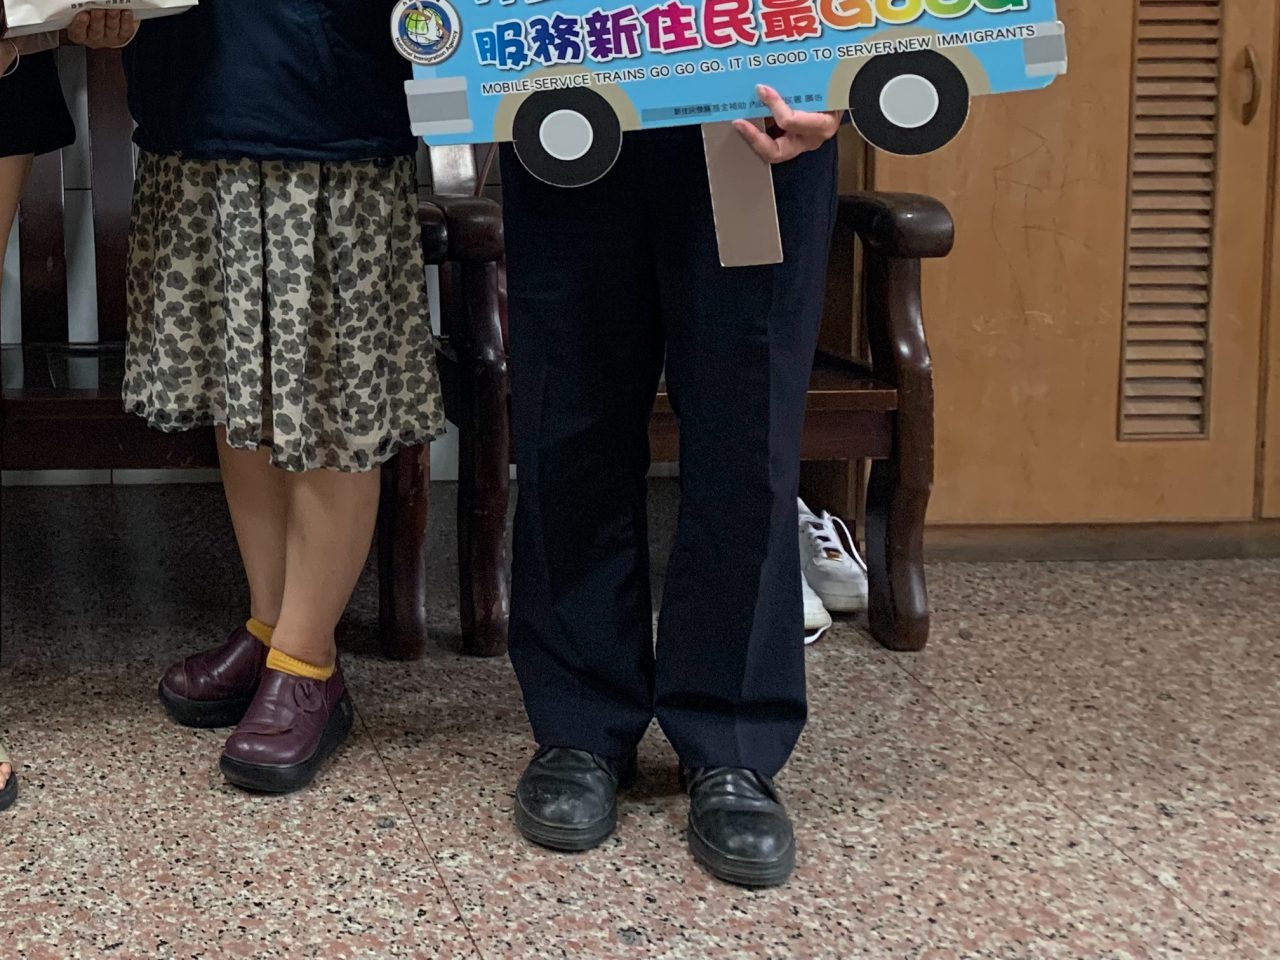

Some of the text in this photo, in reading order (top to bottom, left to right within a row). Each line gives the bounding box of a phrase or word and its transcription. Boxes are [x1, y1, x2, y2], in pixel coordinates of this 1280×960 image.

[482, 74, 590, 94] MOBILE-SERVICE
[595, 70, 645, 83] TRAINS
[650, 66, 669, 77] GO
[675, 63, 695, 74] GO
[701, 60, 724, 72] GO.
[730, 58, 742, 69] IT
[749, 56, 762, 66] IS
[766, 50, 807, 64] GOOD
[812, 48, 832, 60] TO
[898, 36, 931, 51] NEW
[937, 25, 1036, 46] IMMIGRANTS
